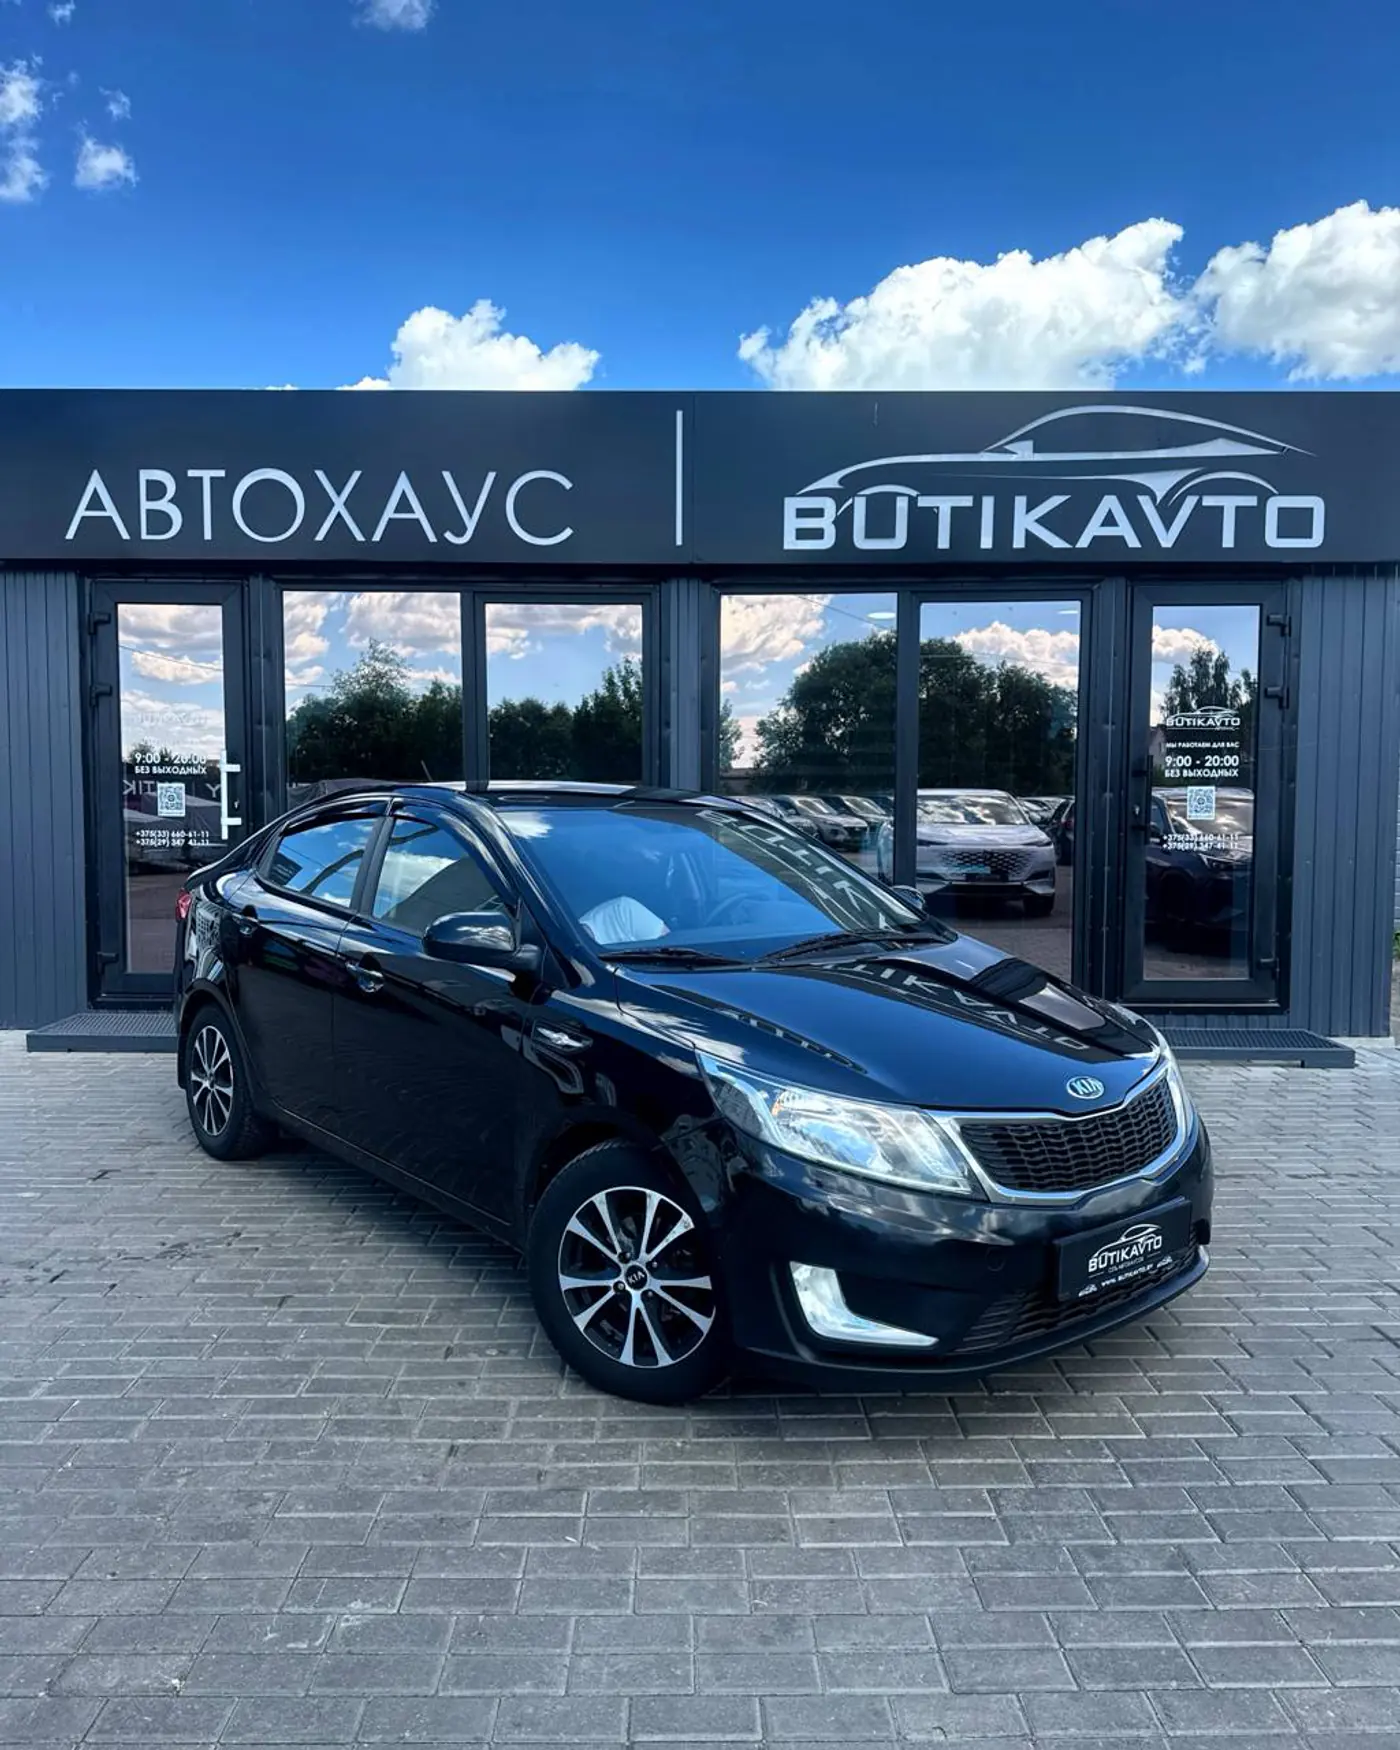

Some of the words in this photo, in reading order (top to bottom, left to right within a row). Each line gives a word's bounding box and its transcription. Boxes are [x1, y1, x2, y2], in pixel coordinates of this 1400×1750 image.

[65, 467, 574, 546] АВТОХАУС
[783, 495, 1326, 551] BUTIKAVTO
[1166, 717, 1240, 726] BUTIKAVTO
[134, 753, 161, 765] 9:00
[1165, 755, 1192, 767] 9:00
[1204, 755, 1240, 767] 20:00
[134, 765, 150, 774] БЕЗ
[152, 765, 207, 775] ВЫХОДНЫХ
[1165, 768, 1180, 778] БЕЗ
[1182, 768, 1239, 778] ВЫХОДНЫХ
[1088, 1235, 1162, 1273] BUTIKAVTO
